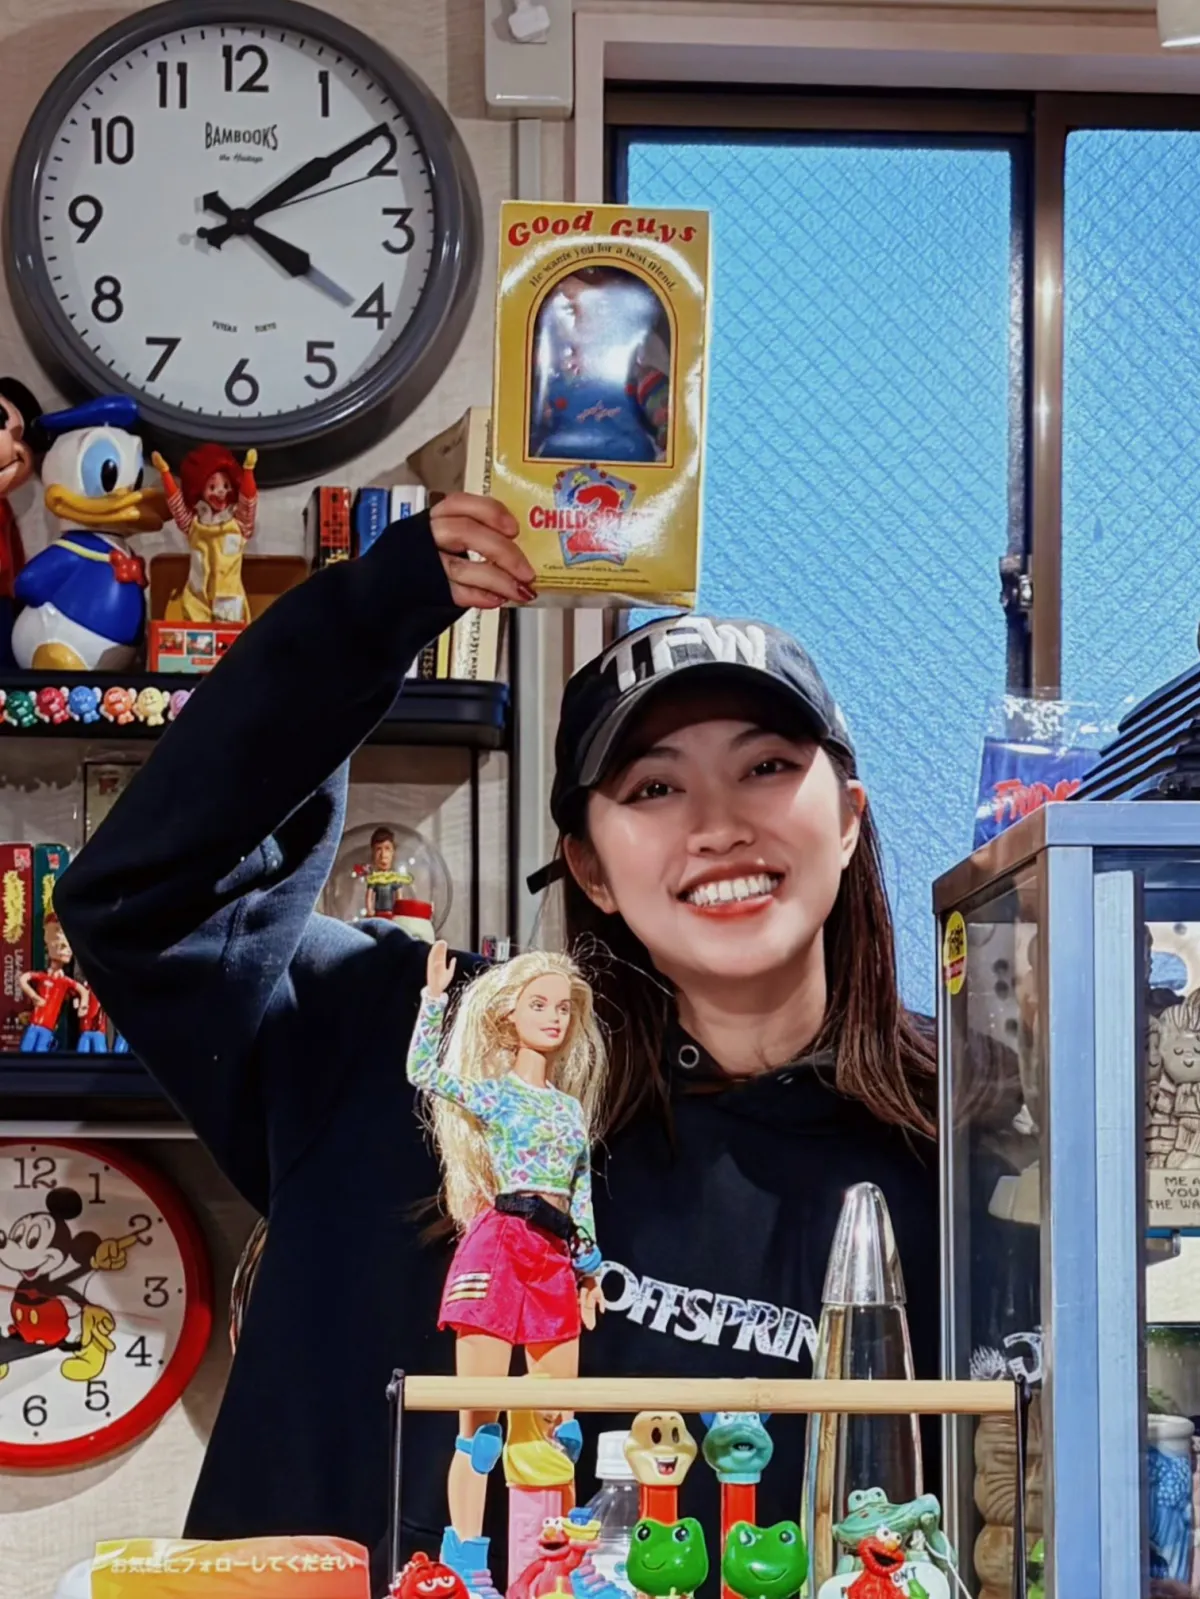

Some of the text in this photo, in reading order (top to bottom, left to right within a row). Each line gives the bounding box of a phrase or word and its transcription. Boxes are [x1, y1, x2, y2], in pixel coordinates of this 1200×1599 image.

[157, 61, 187, 109] 11
[222, 44, 269, 93] 12
[318, 70, 330, 117] 1
[91, 115, 134, 165] 10
[205, 121, 278, 151] BAMBOOKS
[367, 127, 399, 177] 2
[68, 194, 103, 244] 9
[381, 208, 415, 254] 3
[507, 210, 697, 247] Good Guys
[626, 247, 646, 264] best
[91, 276, 123, 323] 8
[352, 282, 392, 330] 4
[145, 337, 181, 382] 7
[304, 341, 338, 390] 5
[224, 359, 260, 406] 6
[13, 1157, 57, 1189] 12
[88, 1173, 106, 1204] 1
[1165, 1176, 1187, 1186] ME
[1167, 1188, 1200, 1197] YOU
[1149, 1200, 1174, 1210] THE
[128, 1214, 153, 1246] 2
[143, 1276, 169, 1307] 3
[599, 1260, 822, 1366] OFFSPRIN
[125, 1336, 153, 1367] 4
[23, 1395, 48, 1426] 6
[85, 1380, 111, 1411] 5
